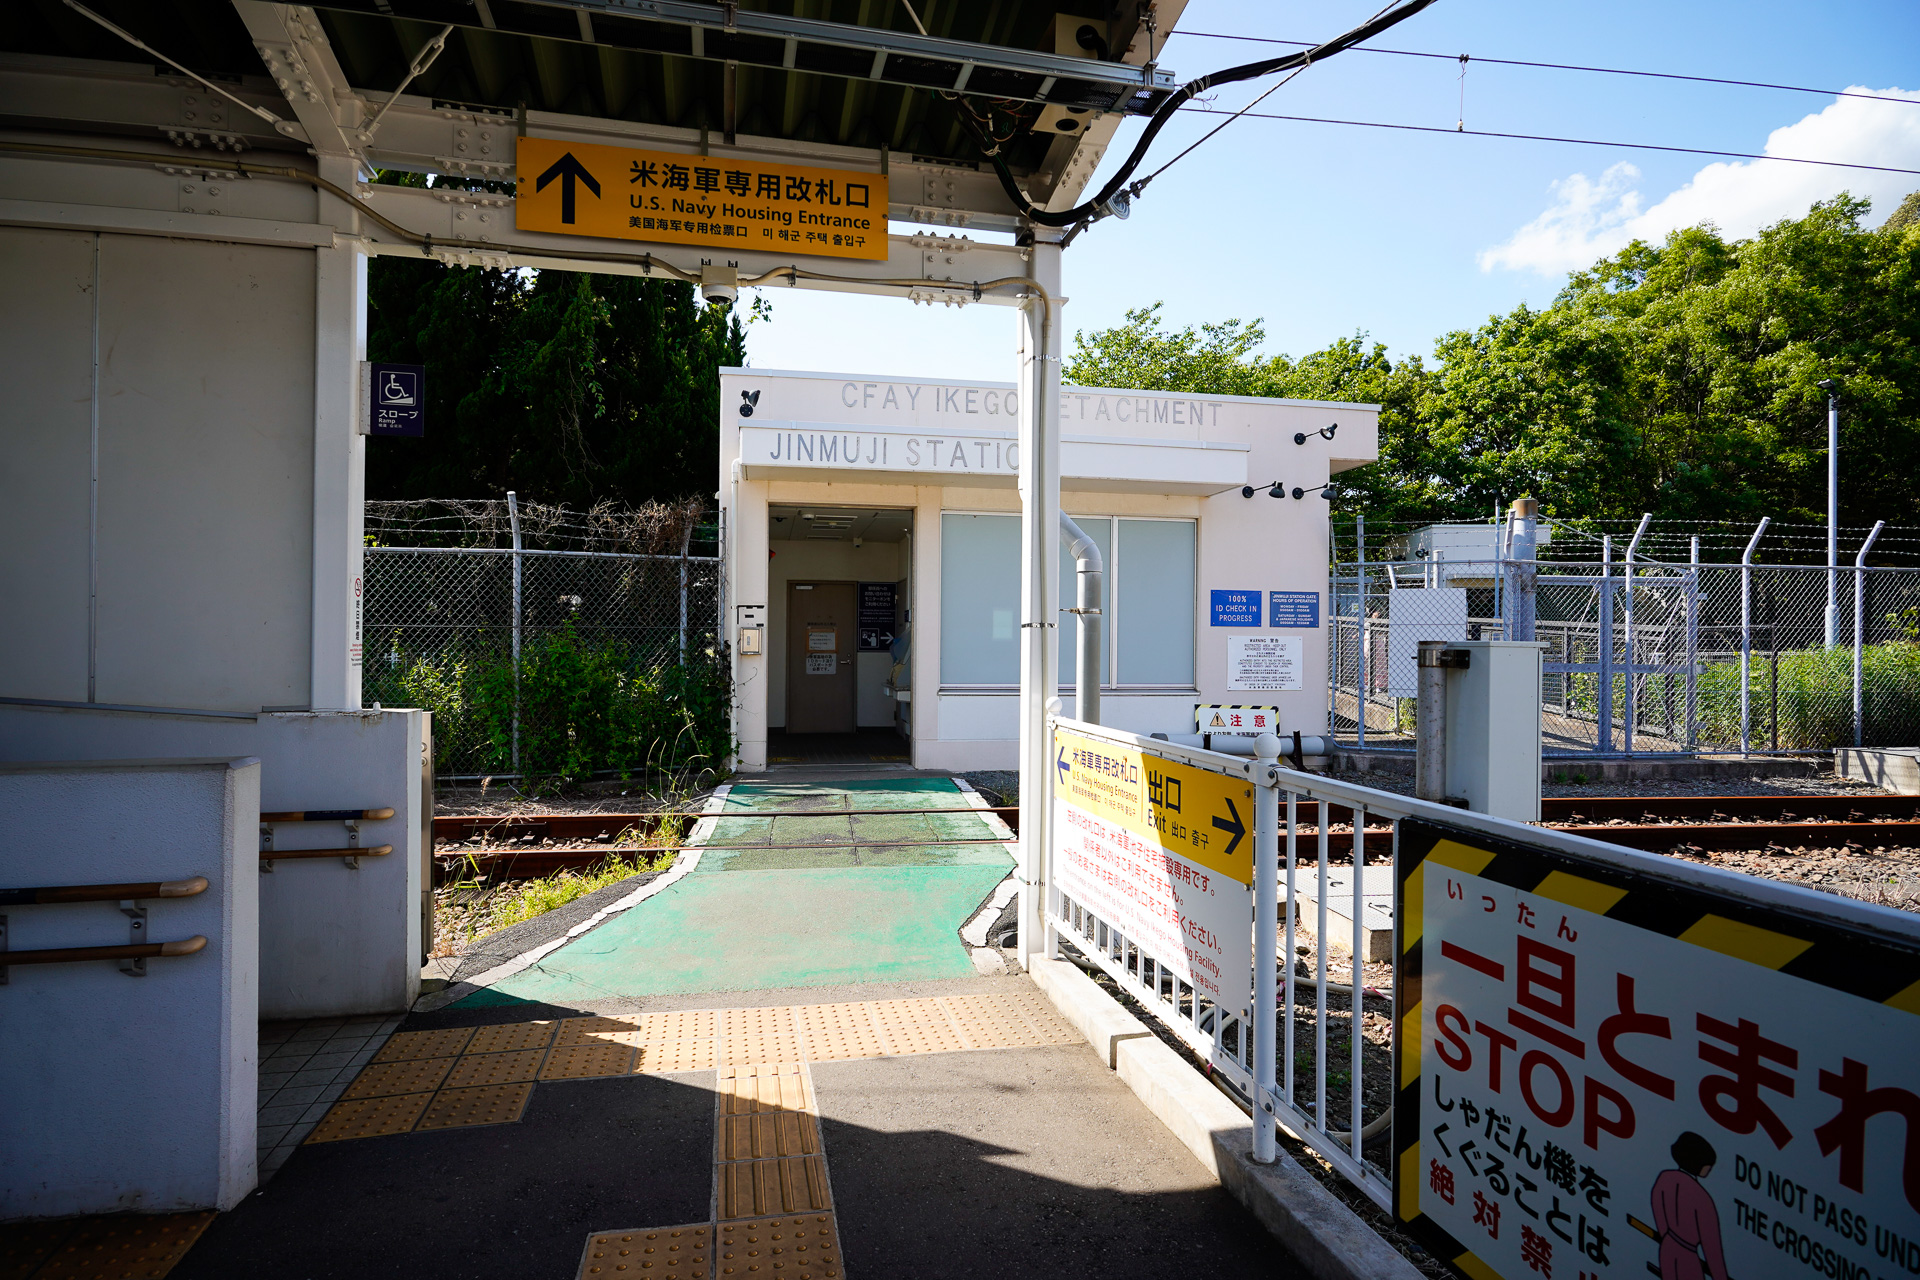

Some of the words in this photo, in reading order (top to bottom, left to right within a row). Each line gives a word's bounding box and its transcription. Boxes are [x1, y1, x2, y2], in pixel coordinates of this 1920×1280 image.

[629, 160, 870, 208] 米海軍専用改札口
[629, 194, 665, 211] U.S.
[672, 198, 716, 219] Navy
[722, 203, 792, 225] Housing
[798, 210, 871, 230] Entrance
[629, 216, 748, 237] 美国海军专用检票口
[763, 228, 773, 240] 미
[778, 229, 800, 241] 해군
[806, 231, 828, 245] 주택
[832, 233, 866, 248] 출입구
[379, 409, 419, 419] スロープ
[842, 382, 922, 411] CFAY
[936, 387, 1018, 416] IKEGO
[1060, 394, 1223, 427] ETACHMENT
[770, 433, 888, 464] JINMUJI
[906, 438, 1019, 471] STATIO
[1215, 604, 1224, 612] ID
[1225, 604, 1247, 613] CHECK
[1249, 605, 1257, 613] IN
[1219, 614, 1253, 622] PROGRESS
[1228, 595, 1247, 603] 100%
[1230, 714, 1266, 727] 注意
[1072, 747, 1138, 785] 米海軍専用改札口
[1081, 772, 1093, 788] Navy
[1094, 777, 1113, 797] Housing
[1115, 785, 1138, 804] Entrance
[1148, 769, 1181, 815] 出口
[1148, 808, 1167, 834] Exit
[1171, 821, 1187, 841] 出口
[1191, 829, 1210, 850] 출구
[1446, 878, 1578, 943] いったん
[1168, 932, 1193, 961] Housing
[1195, 950, 1222, 978] Facility.
[1434, 1003, 1637, 1151] STOP
[1434, 1073, 1611, 1218] しゃだん機を
[1433, 1122, 1611, 1267] くぐることは
[1735, 1153, 1762, 1190] DO
[1767, 1170, 1808, 1214] NOT
[1813, 1193, 1868, 1247] PASS
[1430, 1158, 1598, 1280] 絶対禁
[1733, 1197, 1768, 1242] THE
